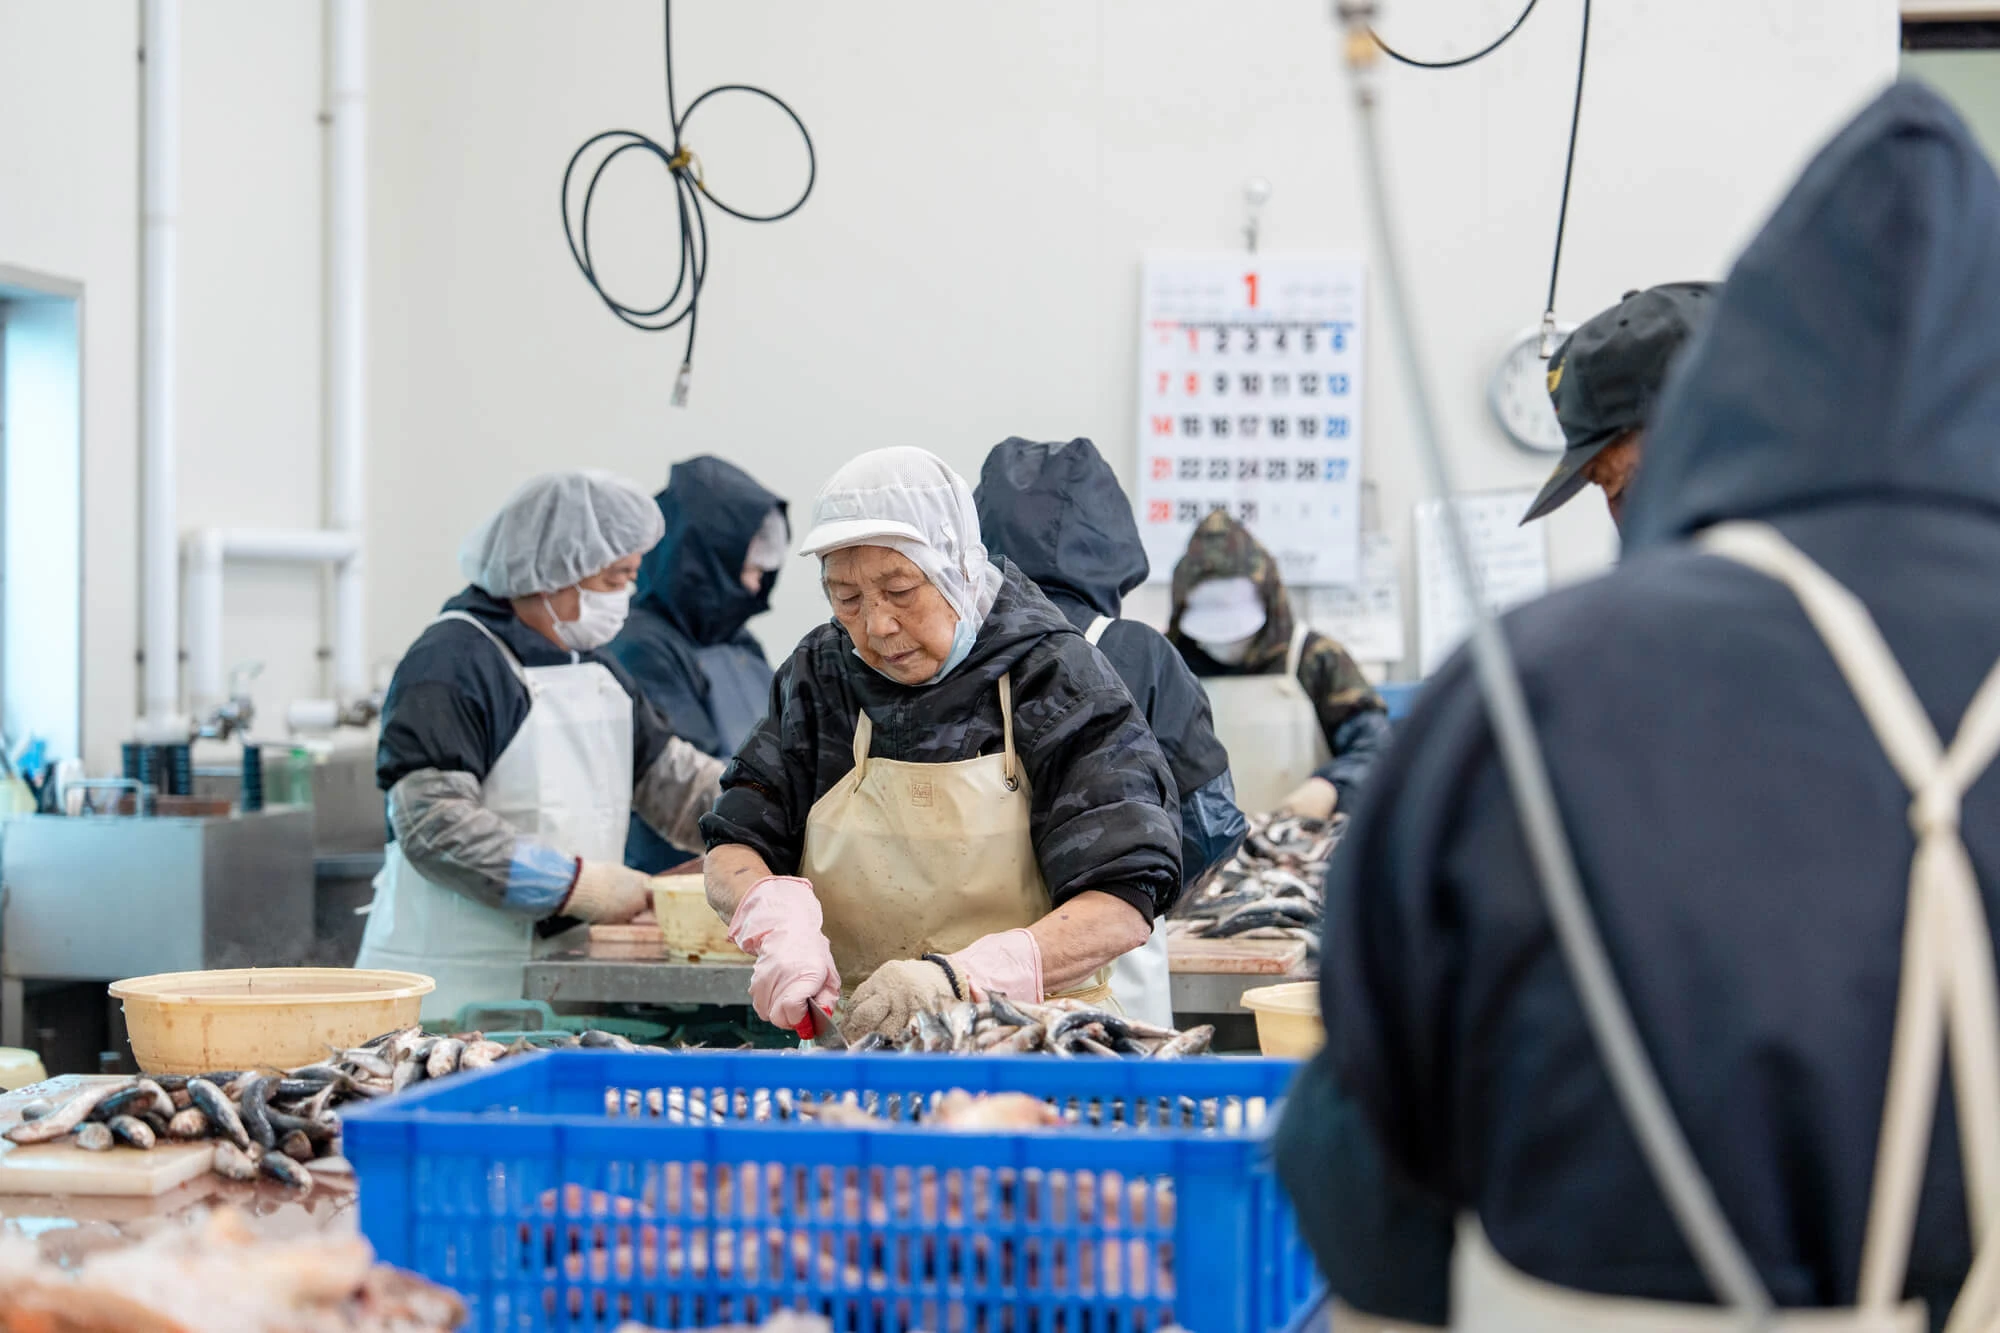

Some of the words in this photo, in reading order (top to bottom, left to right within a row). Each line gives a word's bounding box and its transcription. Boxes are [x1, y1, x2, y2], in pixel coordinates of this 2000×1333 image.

[1244, 273, 1259, 308] 1
[1186, 330, 1198, 351] 1
[1214, 330, 1229, 353] 2
[1244, 330, 1259, 353] 3
[1273, 331, 1288, 352] 4
[1302, 331, 1316, 353] 5
[1331, 331, 1345, 353] 6
[1157, 373, 1169, 395] 7
[1186, 373, 1198, 395] 8
[1214, 373, 1229, 395] 9
[1240, 374, 1261, 395] 10
[1271, 374, 1290, 395] 11
[1299, 374, 1319, 395] 12
[1328, 374, 1349, 396] 13
[1152, 416, 1172, 436] 14
[1181, 416, 1201, 437] 15
[1210, 416, 1230, 437] 16
[1239, 416, 1260, 437] 17
[1269, 416, 1289, 437] 18
[1298, 416, 1319, 438] 19
[1326, 416, 1349, 438] 20
[1151, 458, 1172, 480] 21
[1179, 459, 1201, 480] 22
[1208, 459, 1230, 480] 23
[1237, 459, 1260, 481] 24
[1296, 459, 1319, 480] 26
[1323, 458, 1349, 481] 27
[1149, 501, 1172, 522] 28
